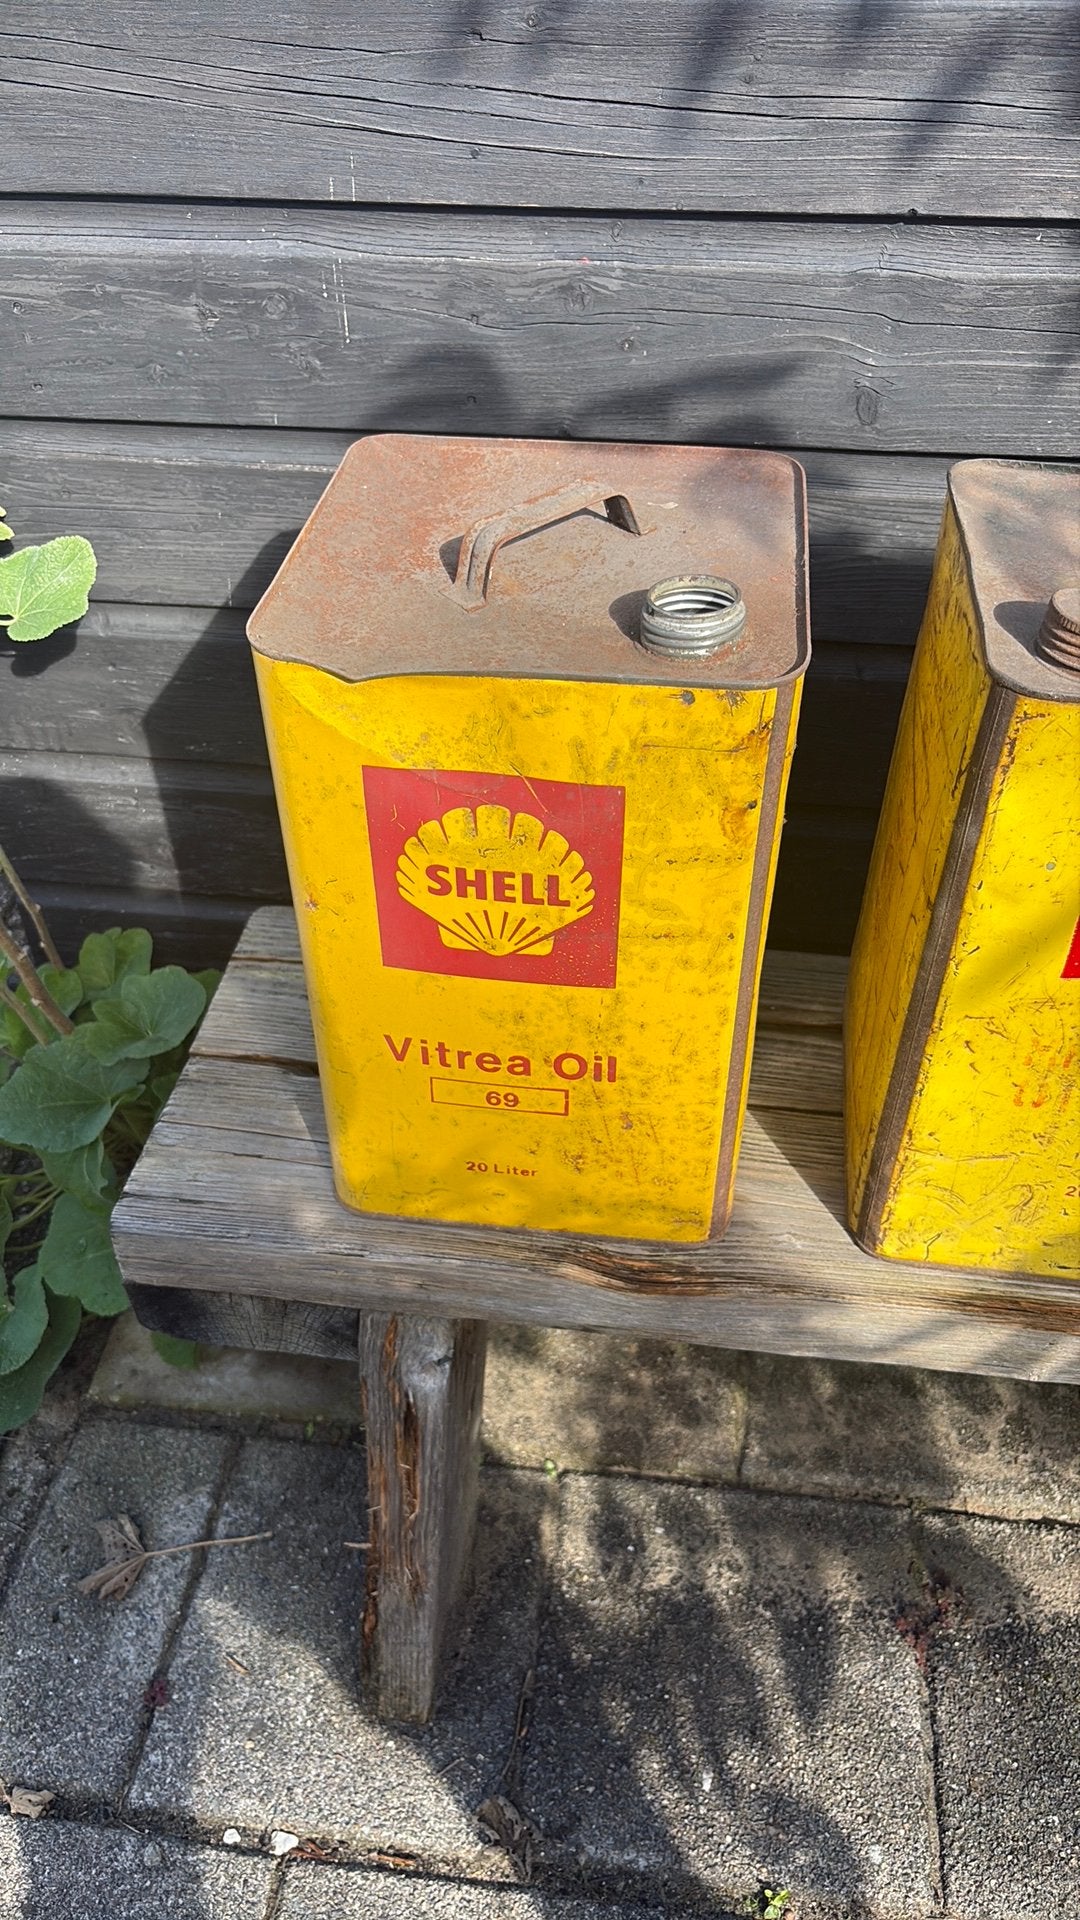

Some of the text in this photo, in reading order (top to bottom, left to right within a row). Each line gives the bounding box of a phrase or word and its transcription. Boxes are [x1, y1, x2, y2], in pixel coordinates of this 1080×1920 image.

[425, 864, 571, 907] SHELL
[383, 1034, 617, 1083] Vitrea Oil
[485, 1091, 520, 1108] 69
[465, 1161, 538, 1177] 20 Liter
[1065, 1185, 1080, 1197] 2
